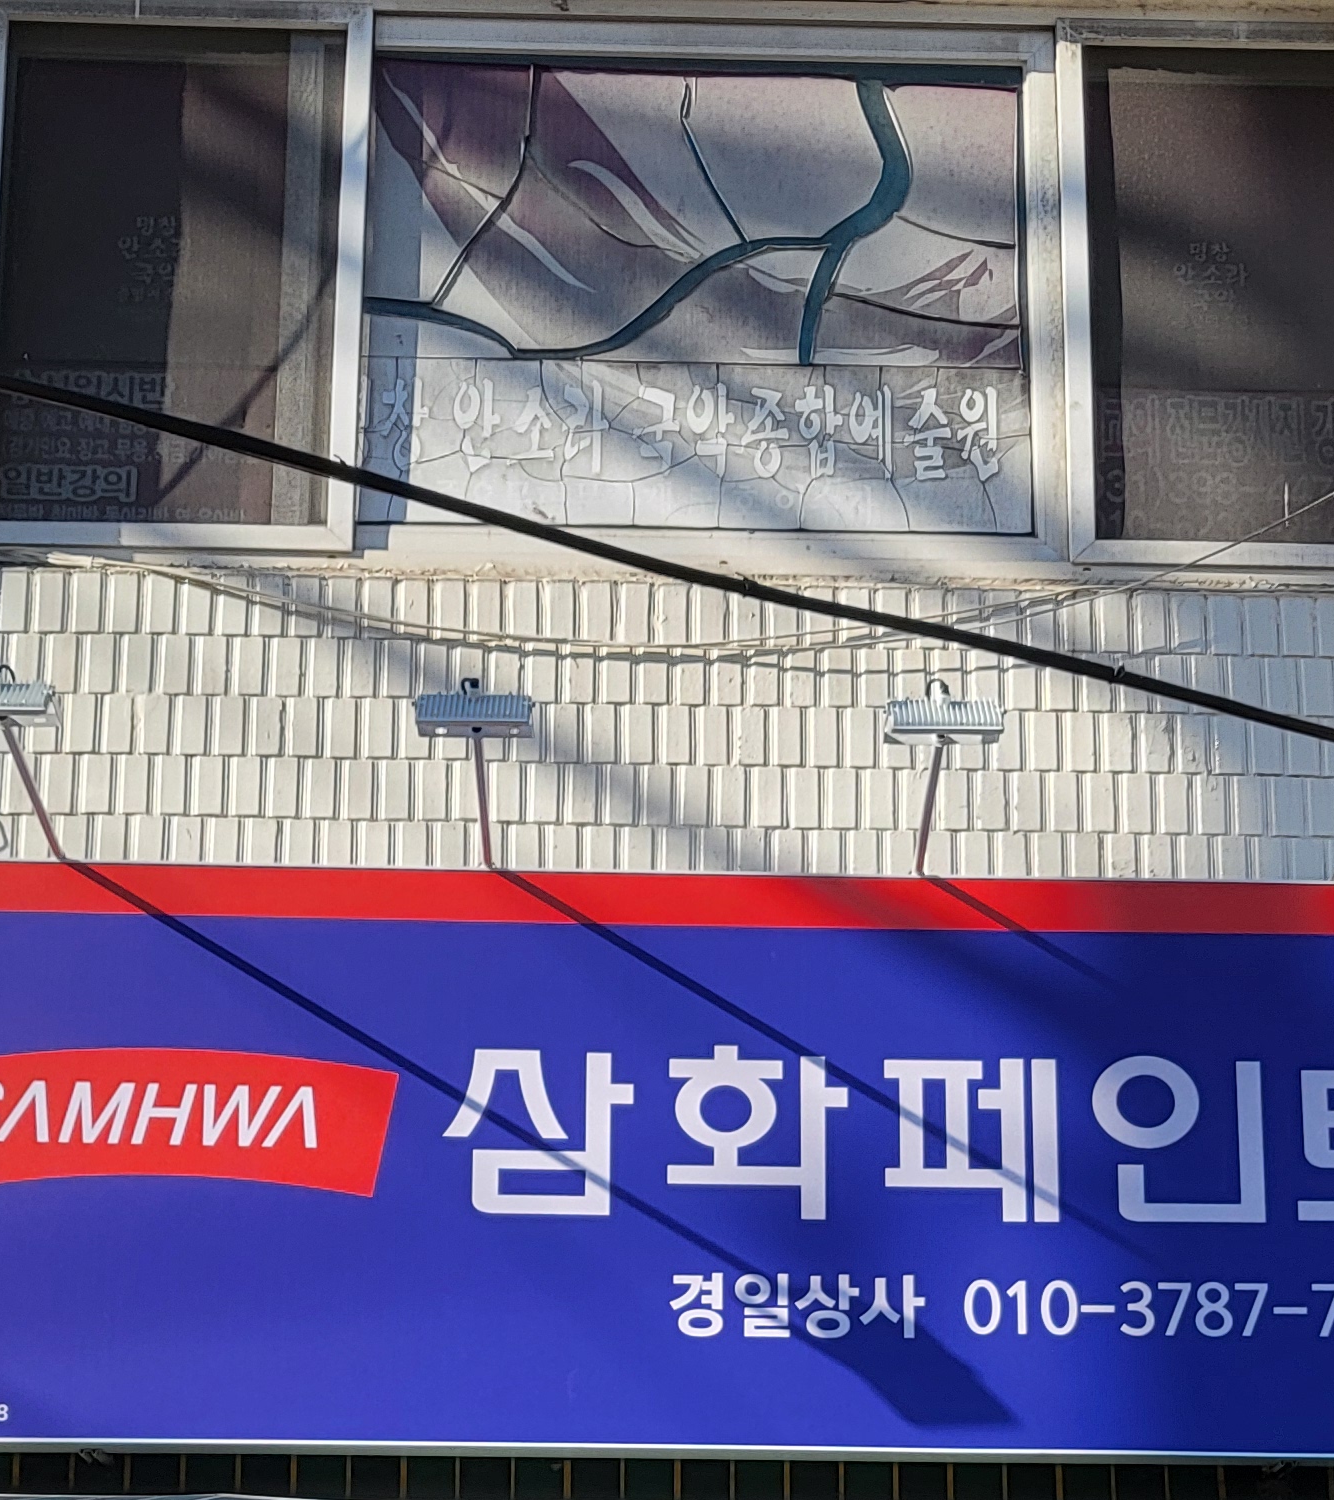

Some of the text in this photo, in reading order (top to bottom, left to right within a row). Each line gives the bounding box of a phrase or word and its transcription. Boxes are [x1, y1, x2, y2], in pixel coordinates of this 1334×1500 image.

[631, 381, 1002, 483] 국악종합예술원
[0, 464, 138, 503] 일반강의
[669, 1272, 926, 1339] 경일상사
